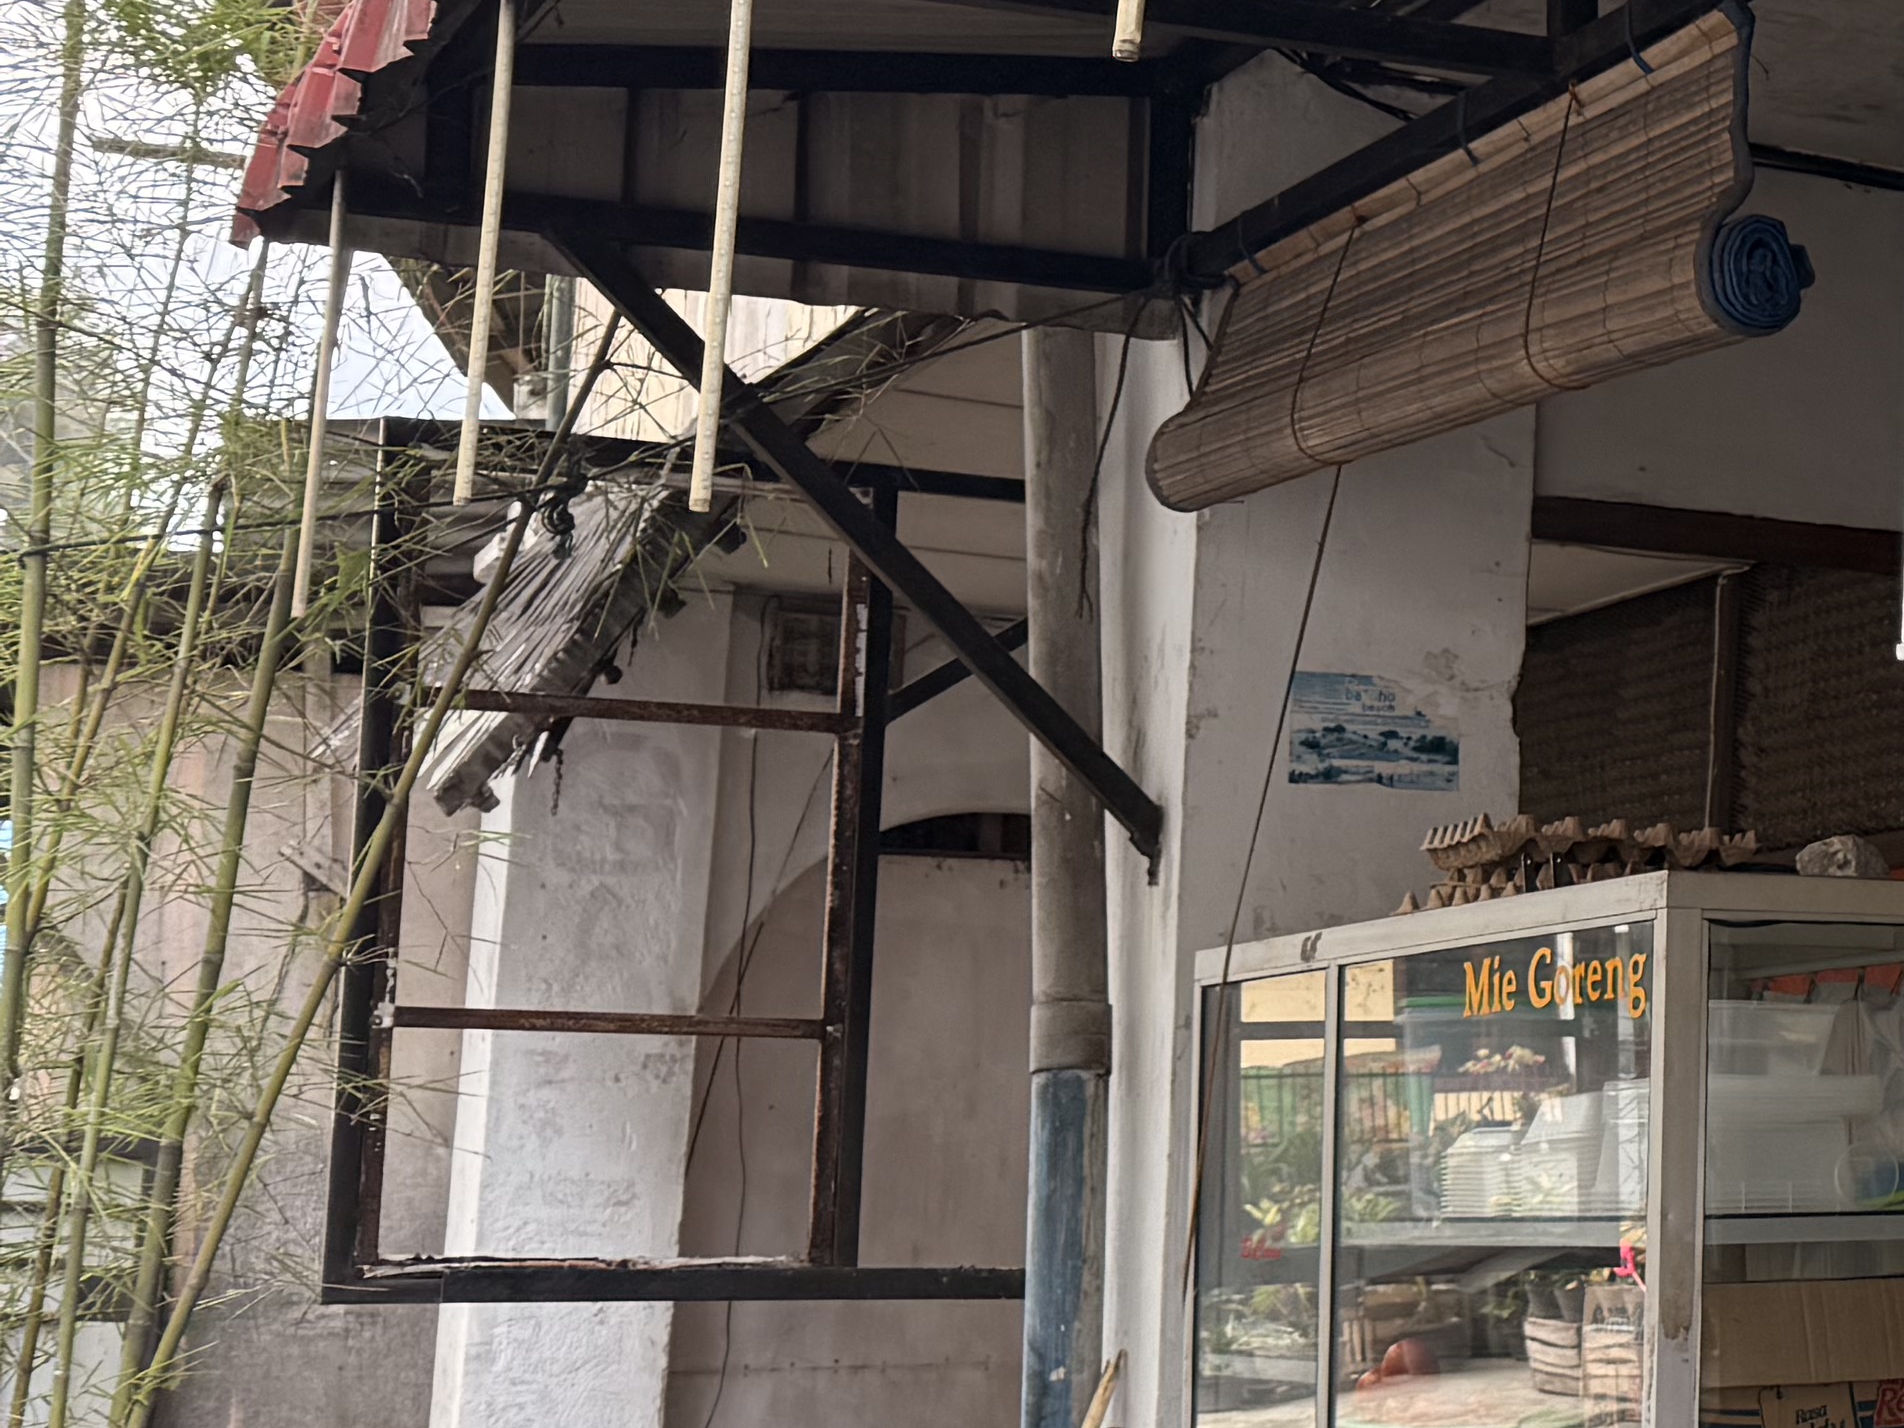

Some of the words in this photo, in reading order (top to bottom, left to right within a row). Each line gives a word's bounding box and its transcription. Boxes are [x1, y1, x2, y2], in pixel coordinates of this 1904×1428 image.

[1462, 956, 1517, 1019] Mie
[1527, 944, 1648, 1019] Goreng
[1795, 1405, 1827, 1425] Rasa
